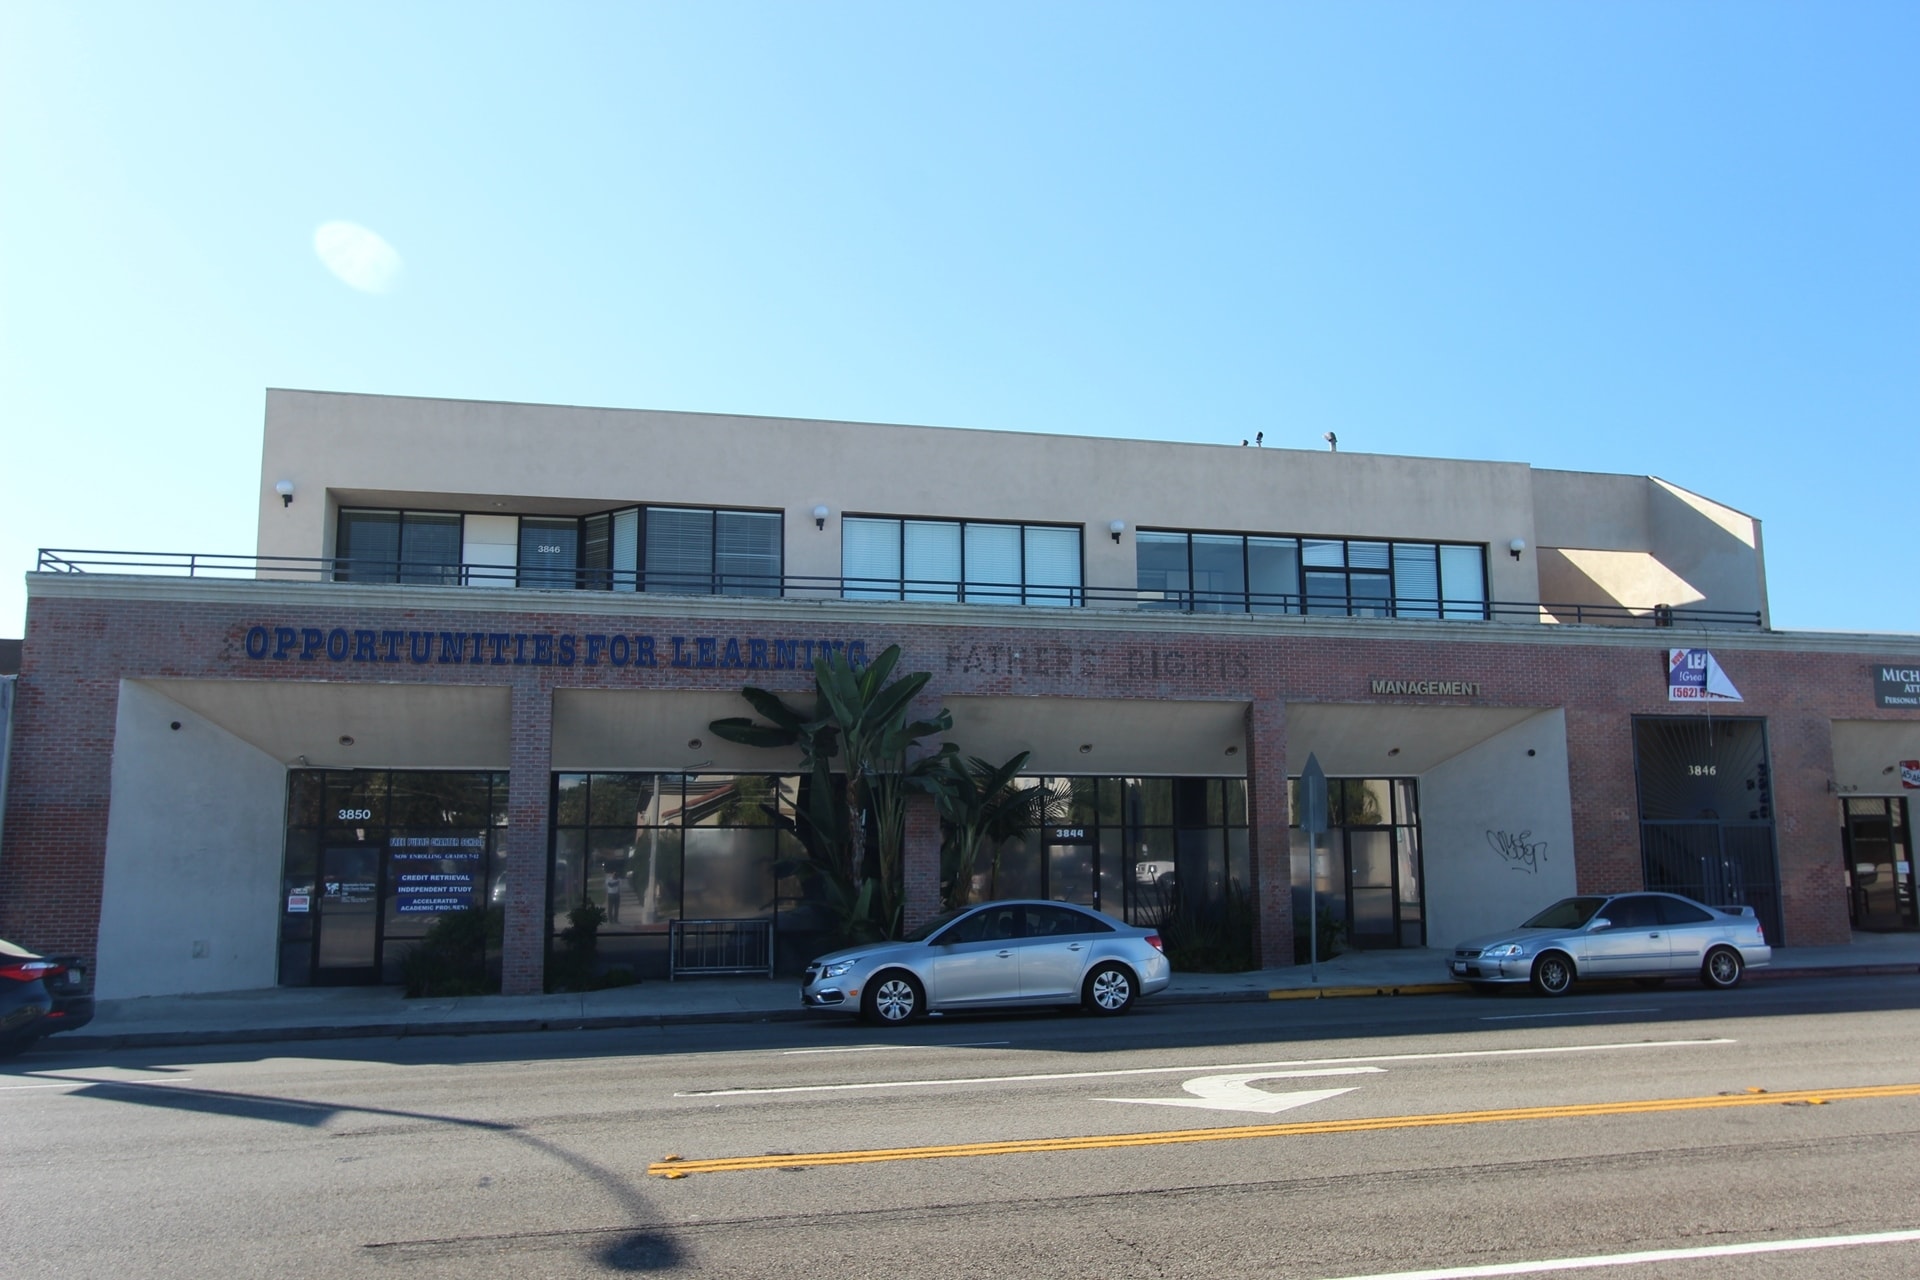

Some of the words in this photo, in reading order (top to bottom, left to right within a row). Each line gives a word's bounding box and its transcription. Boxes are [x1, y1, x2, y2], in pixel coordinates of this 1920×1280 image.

[537, 545, 561, 554] 3846
[245, 625, 576, 667] OPPORTUNITIES
[585, 633, 658, 667] FOR
[1882, 667, 1920, 682] MICH
[1371, 680, 1482, 696] MANAGEMENT
[1673, 687, 1698, 698] (562)
[1884, 696, 1918, 705] PERSONAL
[1687, 765, 1717, 776] 3846
[338, 809, 372, 820] 3850
[1056, 829, 1084, 838] 3844
